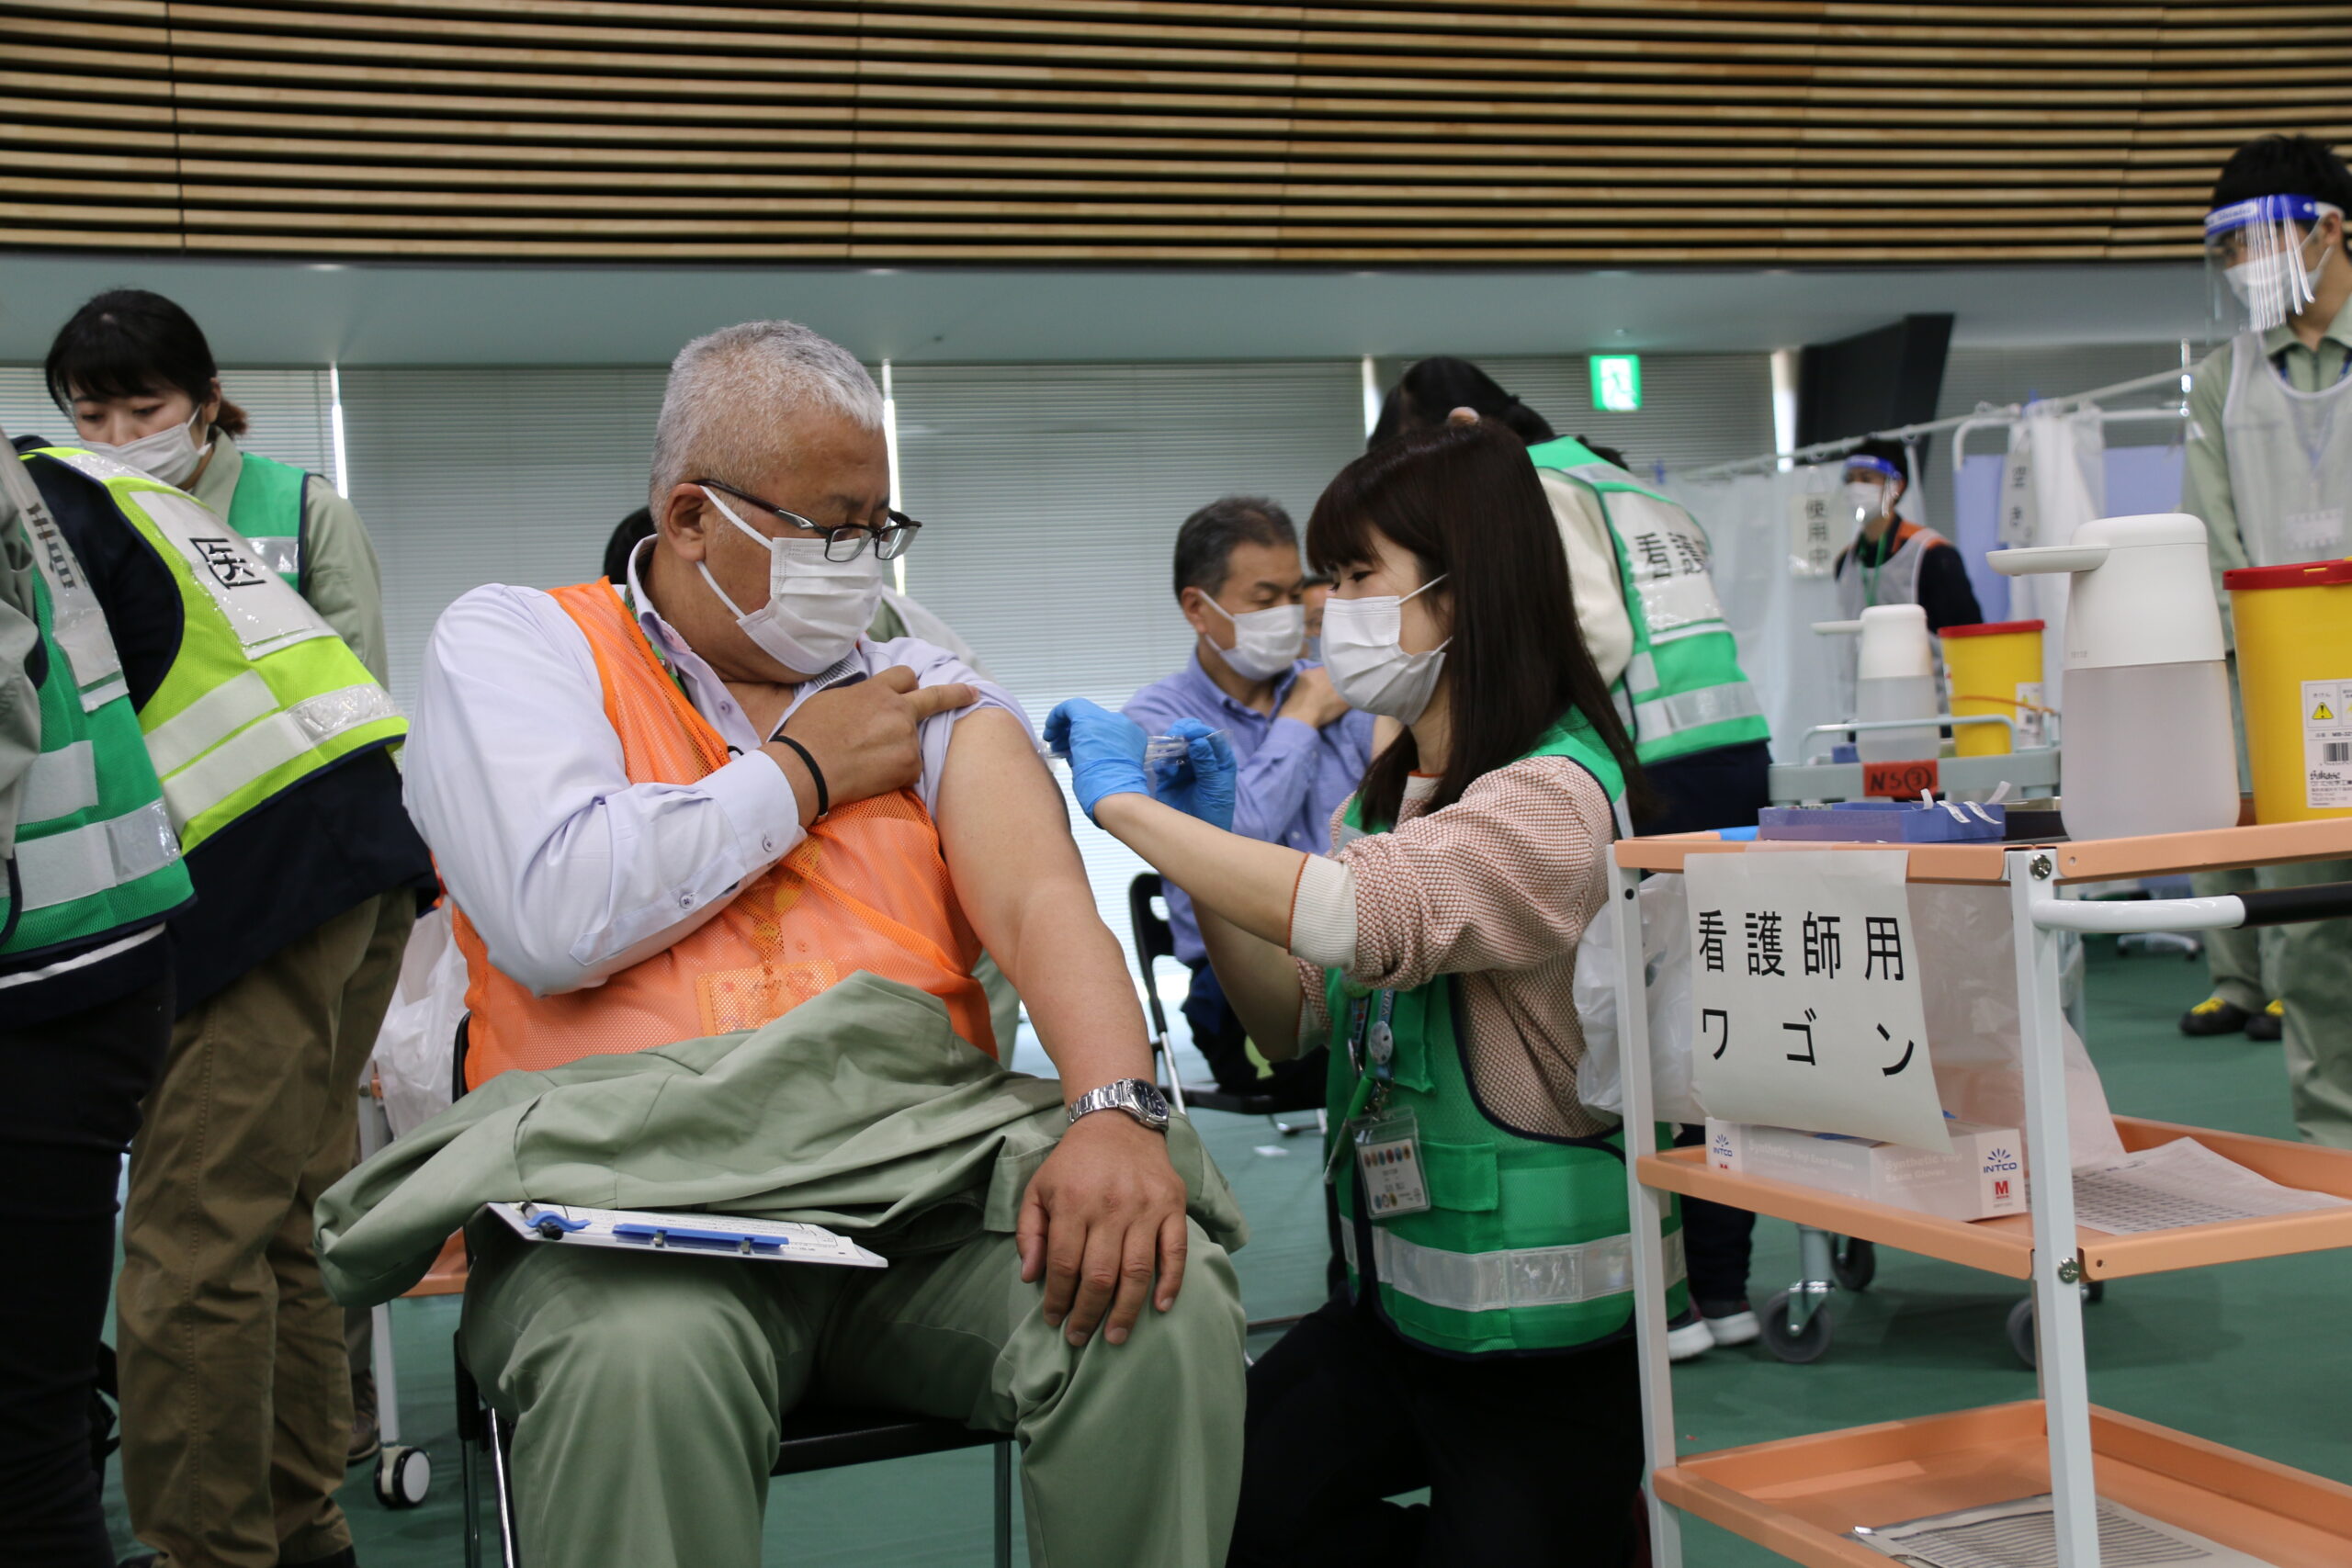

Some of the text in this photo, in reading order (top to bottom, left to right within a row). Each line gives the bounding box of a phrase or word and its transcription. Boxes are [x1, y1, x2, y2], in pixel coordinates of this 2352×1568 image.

[1805, 498, 1828, 567] 使用中
[1698, 909, 1905, 981] 看護師用
[1702, 1007, 1915, 1077] ワゴン
[1713, 1147, 1734, 1157] INTCO
[1884, 1154, 1940, 1172] Synthetic
[1983, 1161, 2018, 1174] INTCO
[1995, 1180, 2009, 1196] M
